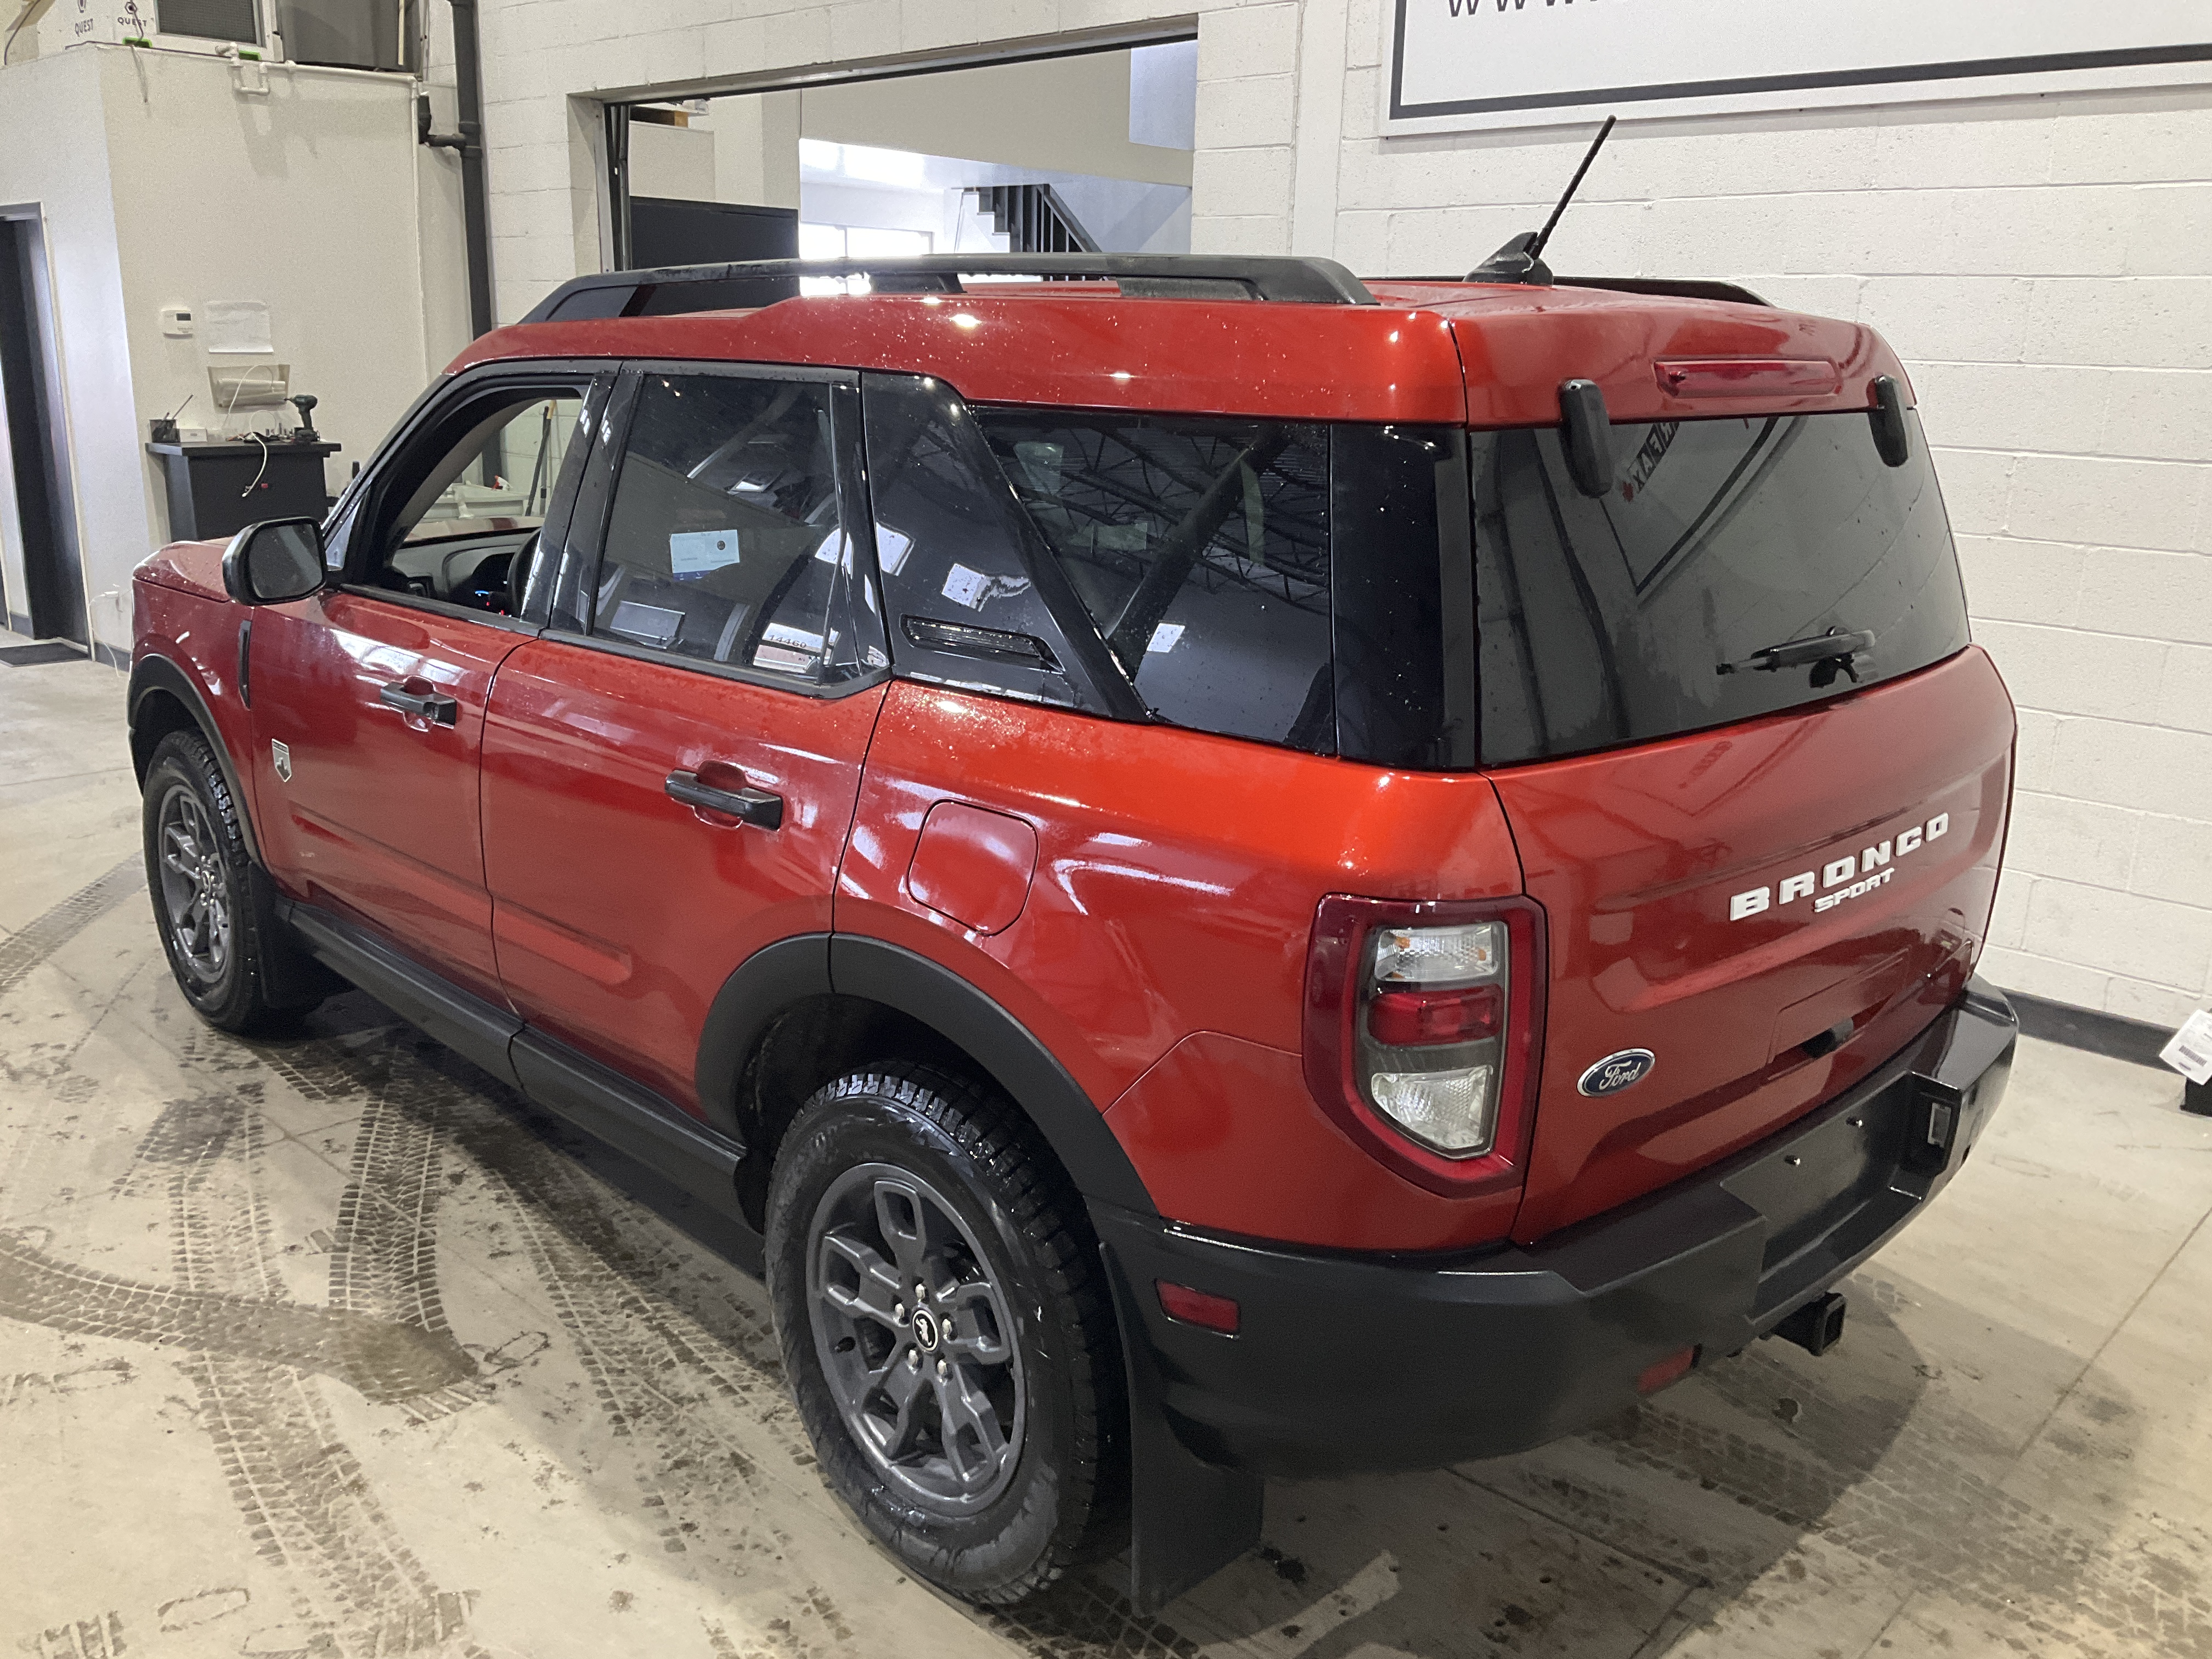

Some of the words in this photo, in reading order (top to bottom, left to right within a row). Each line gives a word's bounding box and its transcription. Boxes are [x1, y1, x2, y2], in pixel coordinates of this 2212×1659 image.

[75, 18, 94, 37] QUEST
[769, 635, 807, 648] 14460
[1730, 812, 1949, 921] BRONCO
[1814, 868, 1895, 913] SPORT
[1599, 1060, 1641, 1090] Ford
